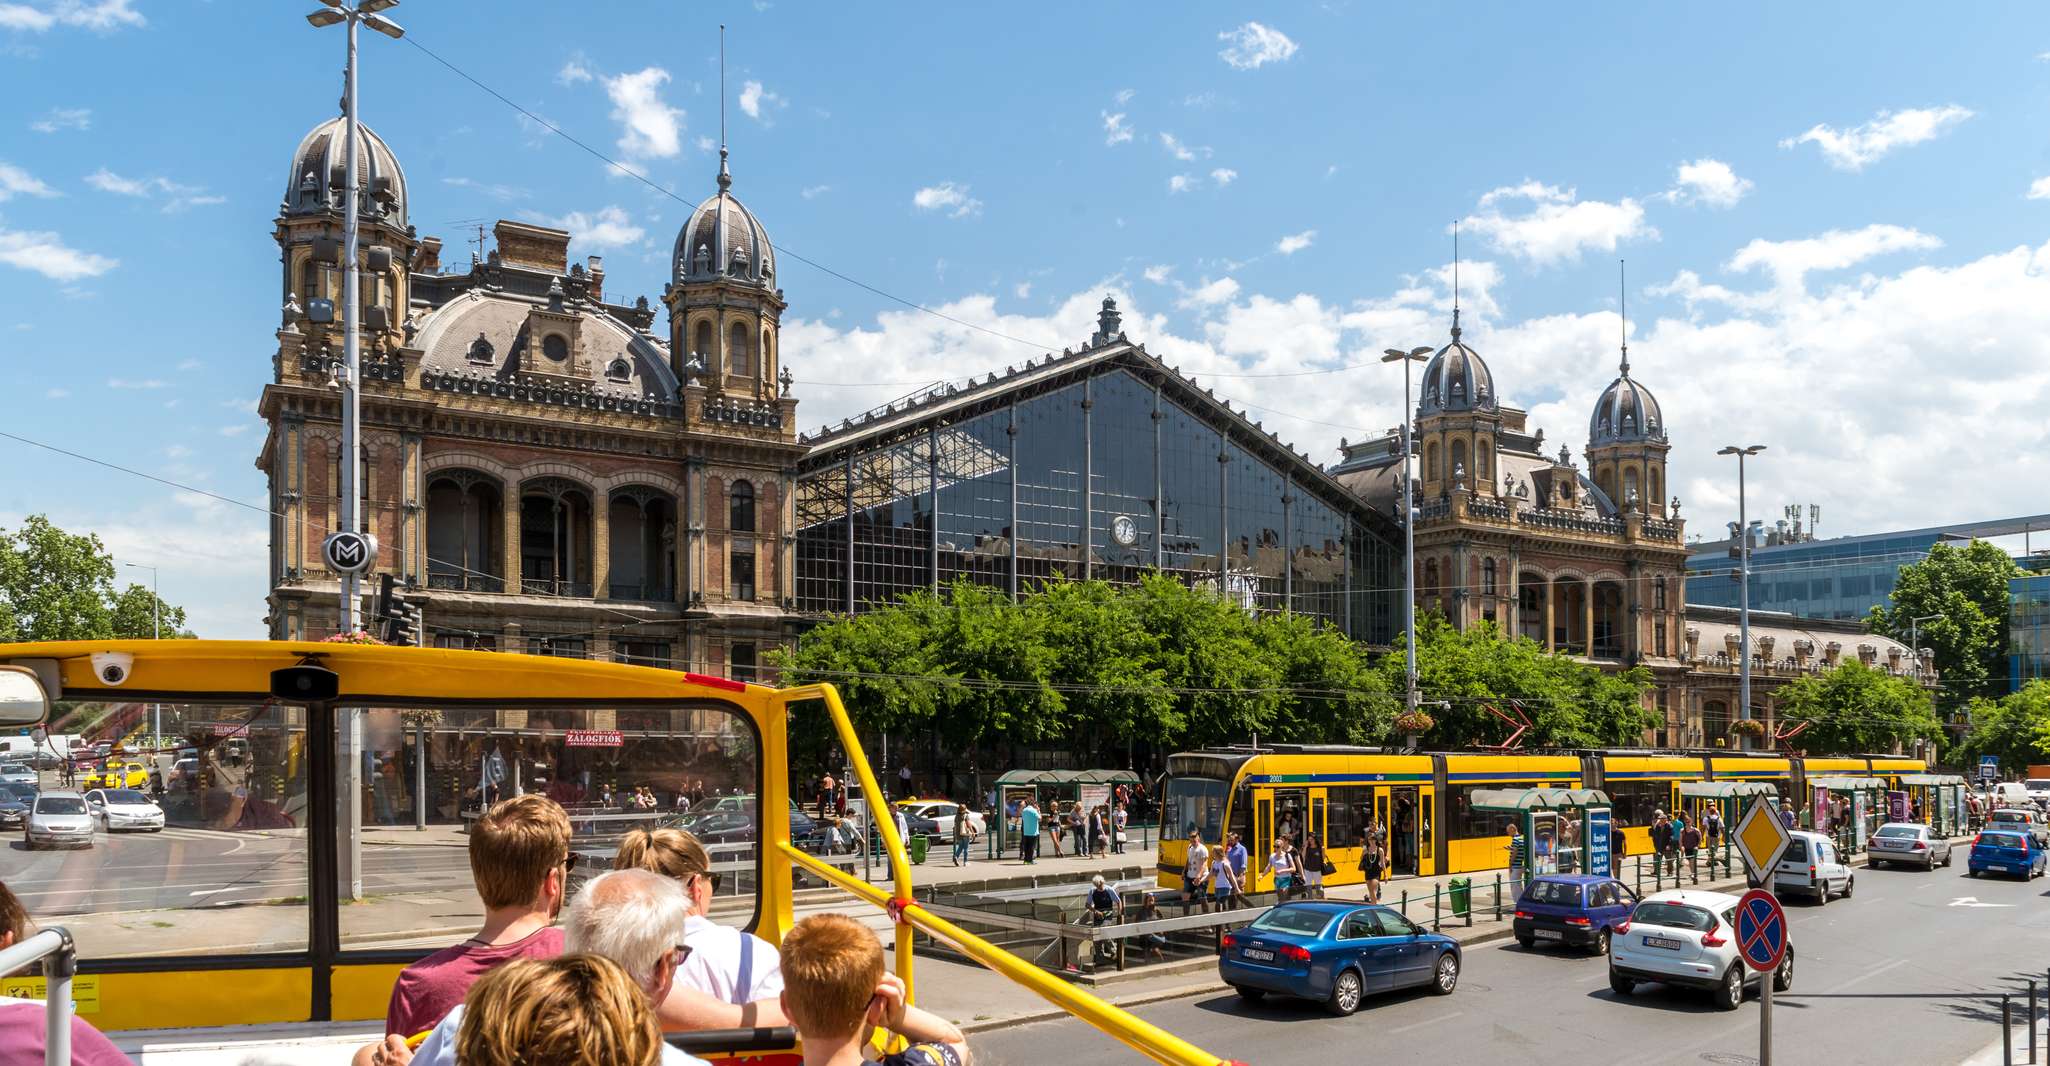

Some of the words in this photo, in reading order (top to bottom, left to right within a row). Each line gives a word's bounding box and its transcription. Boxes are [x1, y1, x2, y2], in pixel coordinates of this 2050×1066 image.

[336, 540, 360, 562] M
[567, 732, 622, 743] ZÁLOGFIÓK
[1269, 775, 1283, 783] 2003
